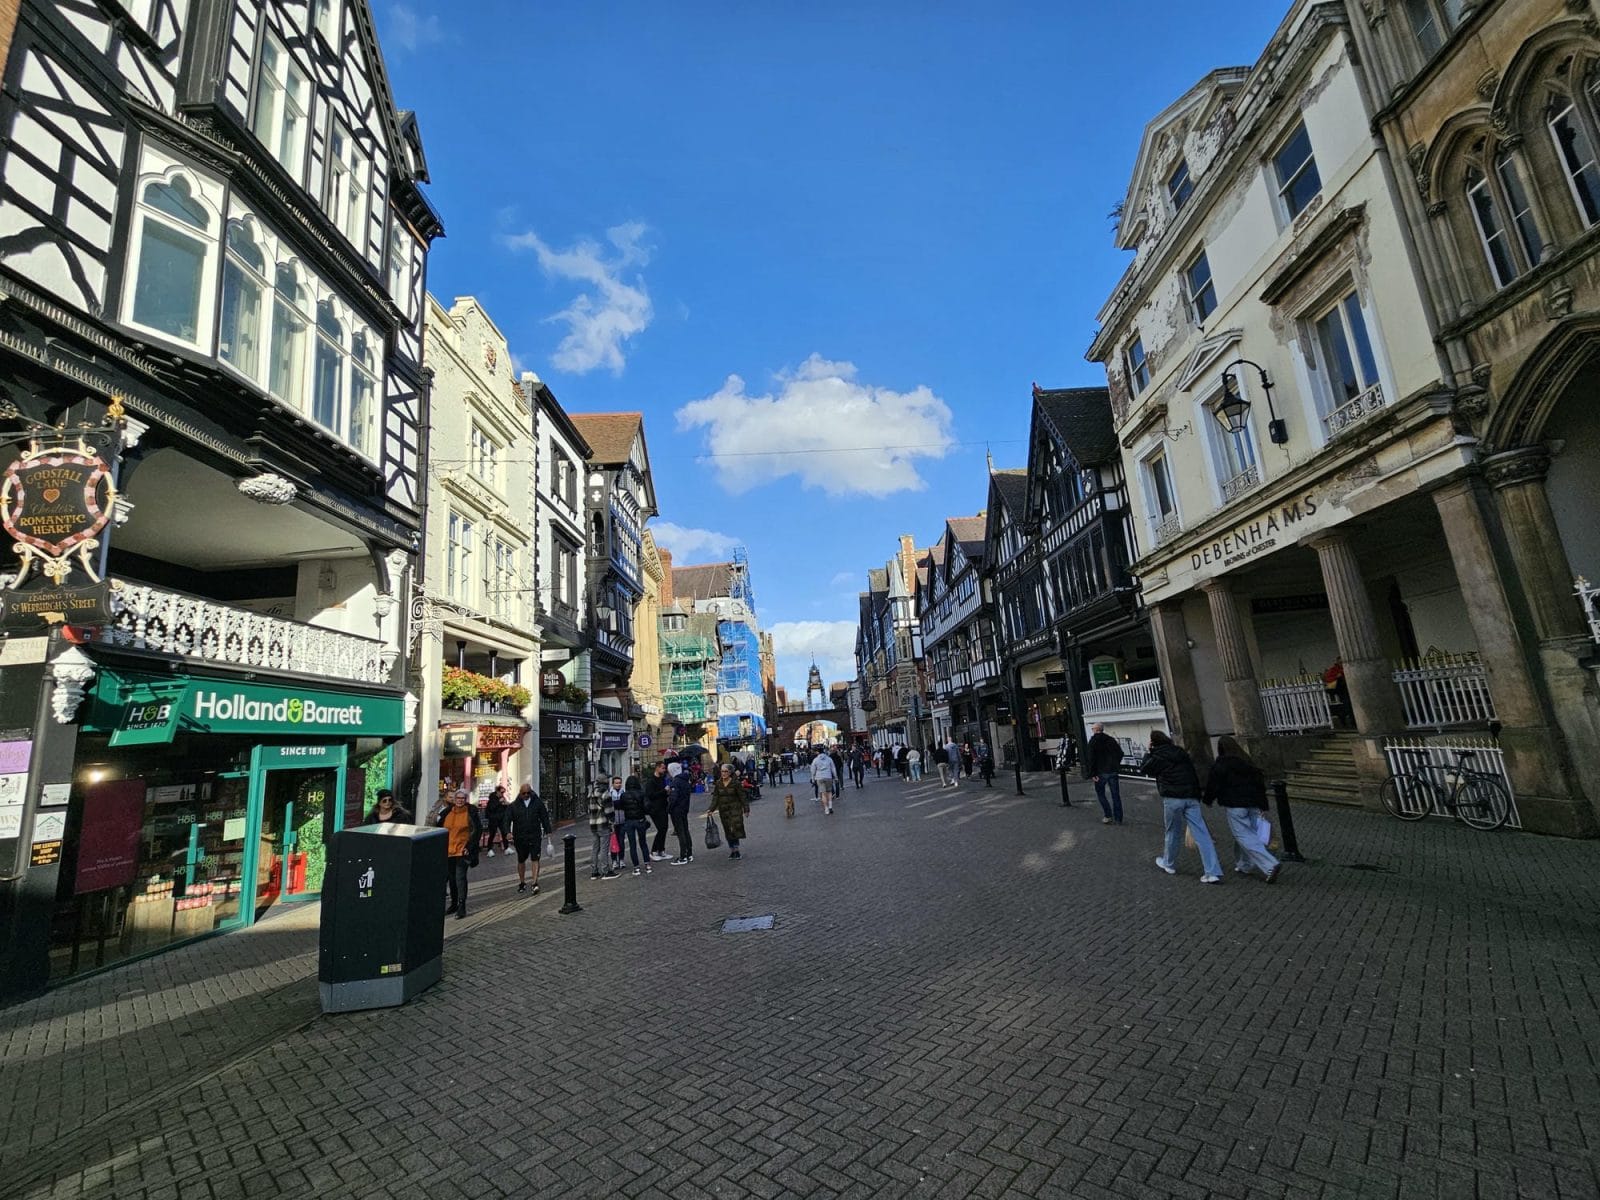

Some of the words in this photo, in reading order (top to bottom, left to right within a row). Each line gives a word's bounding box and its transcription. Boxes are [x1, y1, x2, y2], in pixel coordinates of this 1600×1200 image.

[26, 468, 82, 484] GODSTALL
[37, 480, 68, 489] LANE
[20, 514, 86, 527] ROMANTIC
[33, 524, 72, 535] HEART
[1191, 494, 1317, 571] DEBENHAMS
[1251, 538, 1277, 555] CHESTER
[29, 592, 62, 602] LEADING
[69, 598, 97, 610] STREET
[557, 719, 570, 733] Bella
[280, 746, 306, 756] SINCE
[308, 746, 326, 756] 1870
